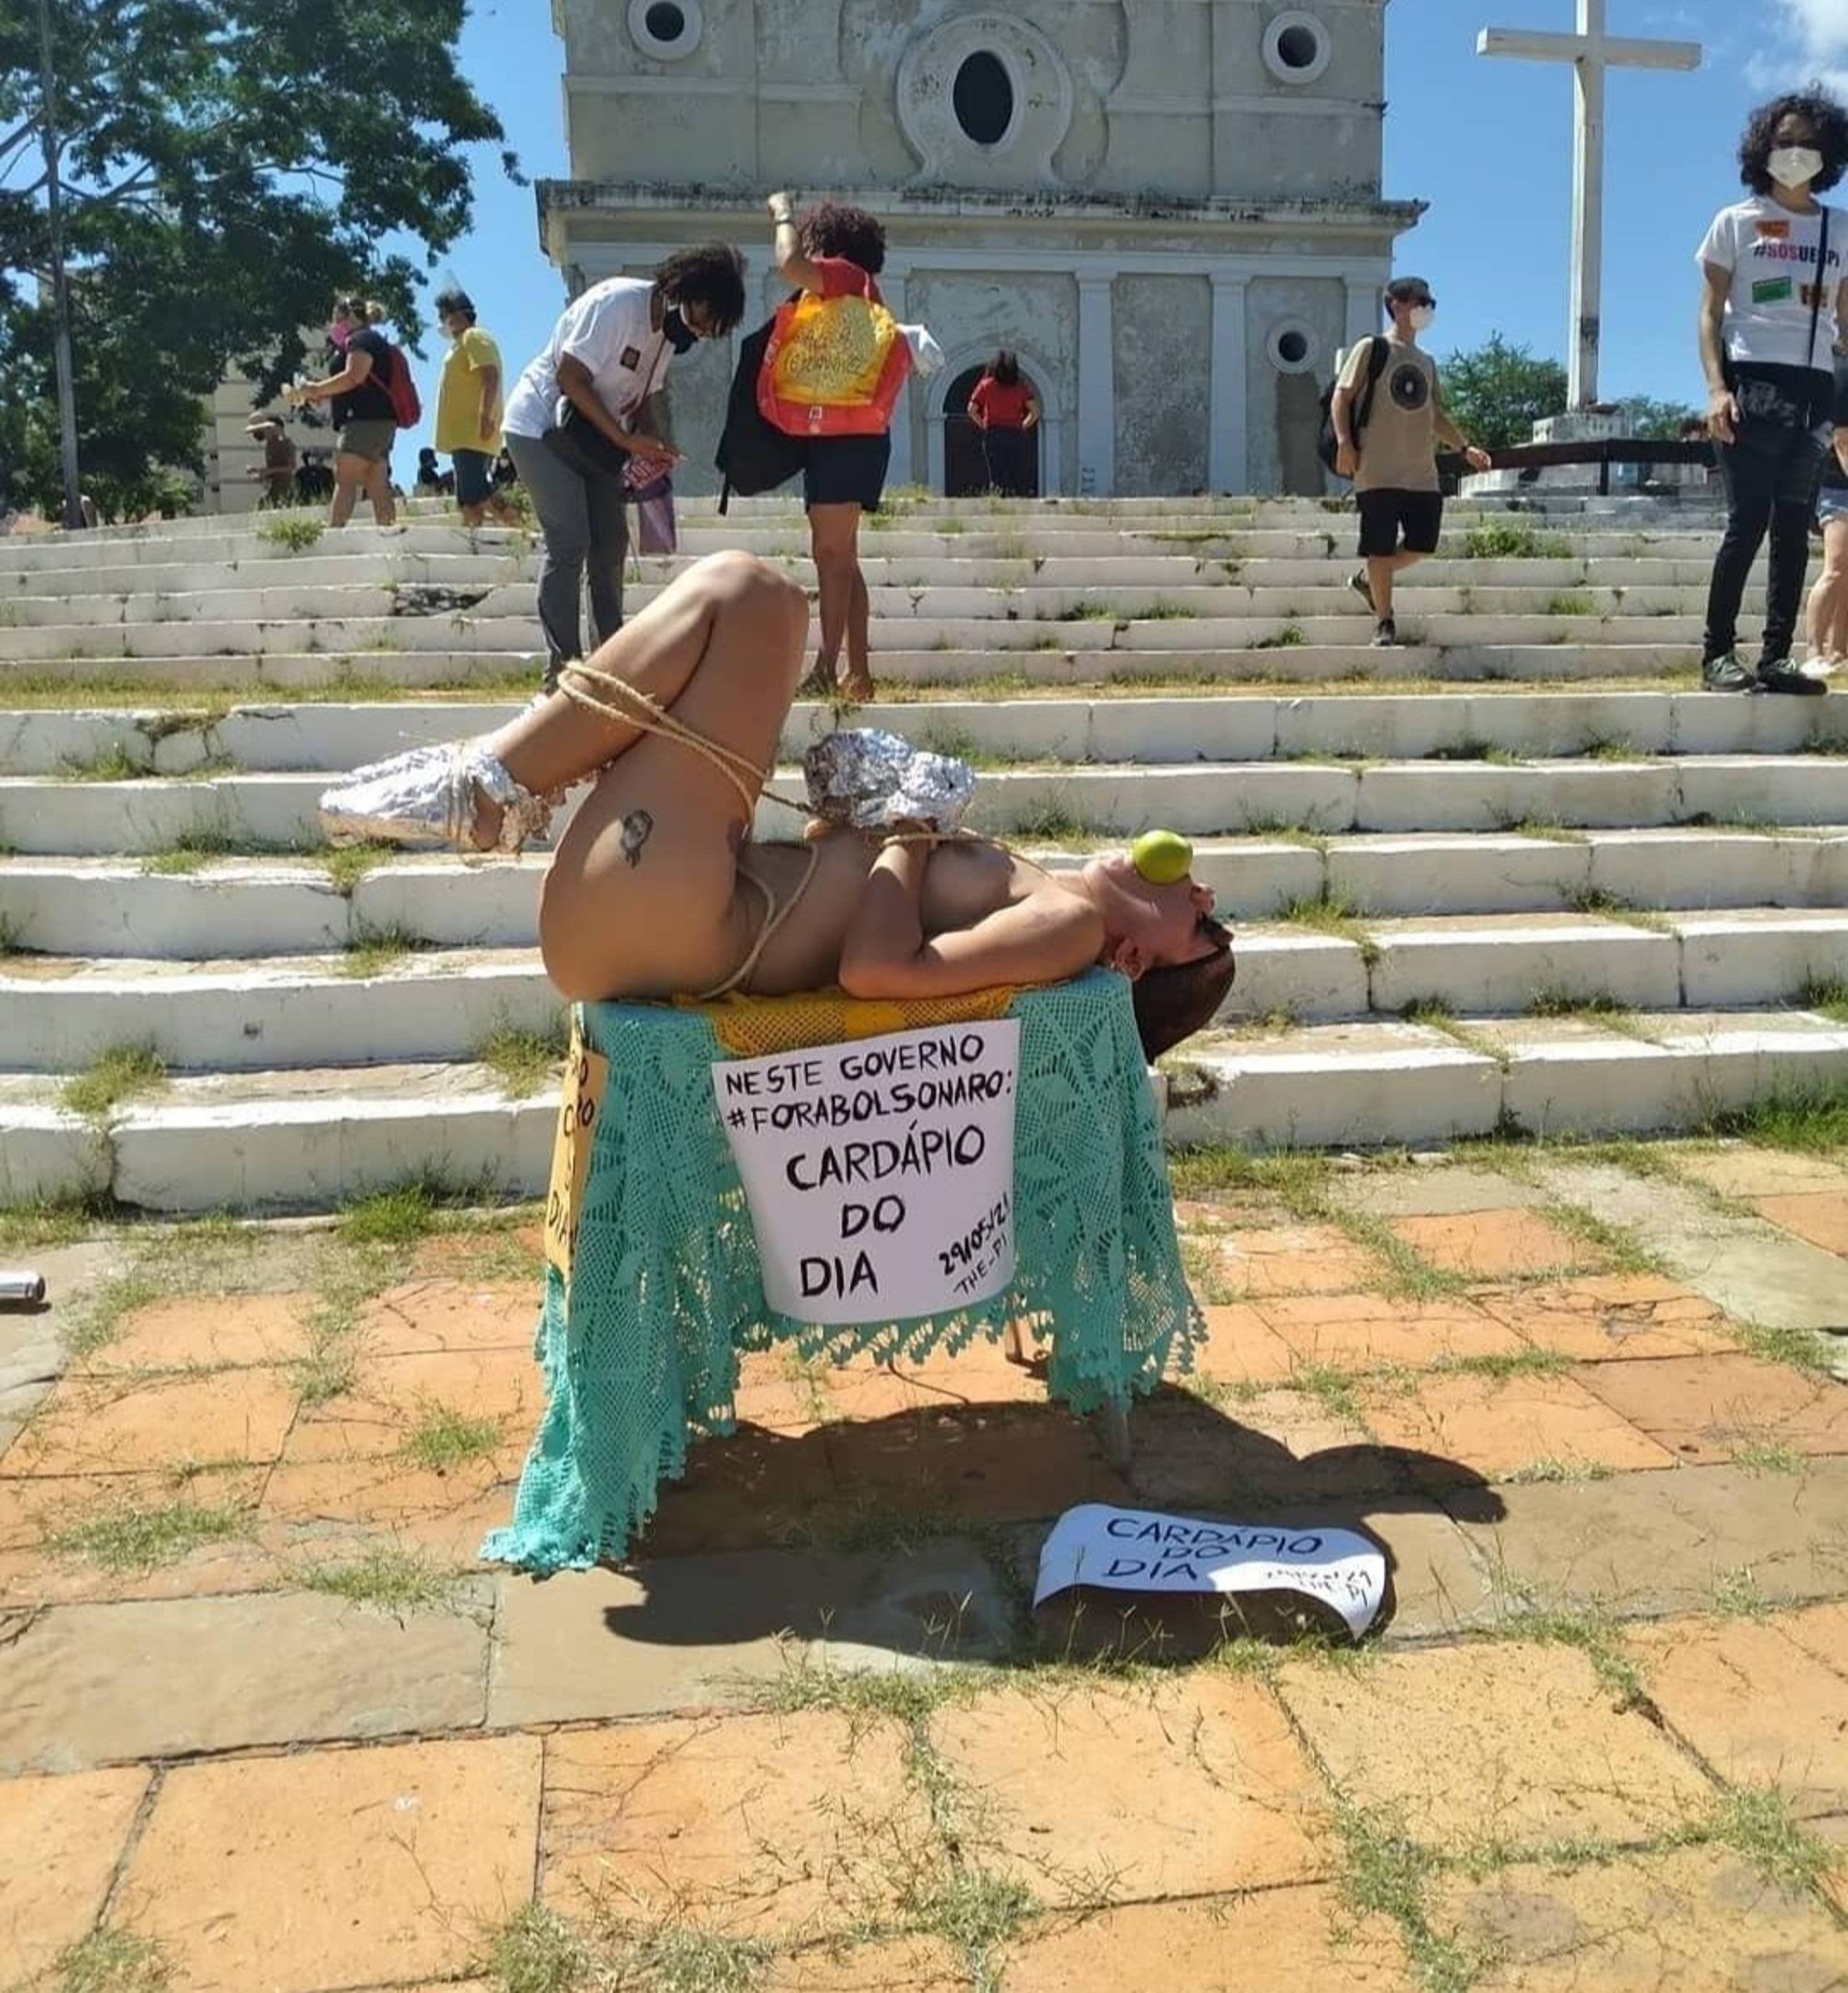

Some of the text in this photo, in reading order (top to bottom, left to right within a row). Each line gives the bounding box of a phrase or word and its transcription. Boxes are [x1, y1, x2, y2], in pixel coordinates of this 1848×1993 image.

[726, 1033, 985, 1095] NESTE GOVERNO
[727, 1069, 1013, 1134] #FORABOLSONARO:
[786, 1119, 986, 1191] CARDÁPIO
[840, 1194, 906, 1239] DO
[800, 1251, 879, 1299] DIA
[1107, 1517, 1324, 1555] CARDÁPIO
[1161, 1545, 1230, 1559] DO
[1104, 1558, 1198, 1581] DIA
